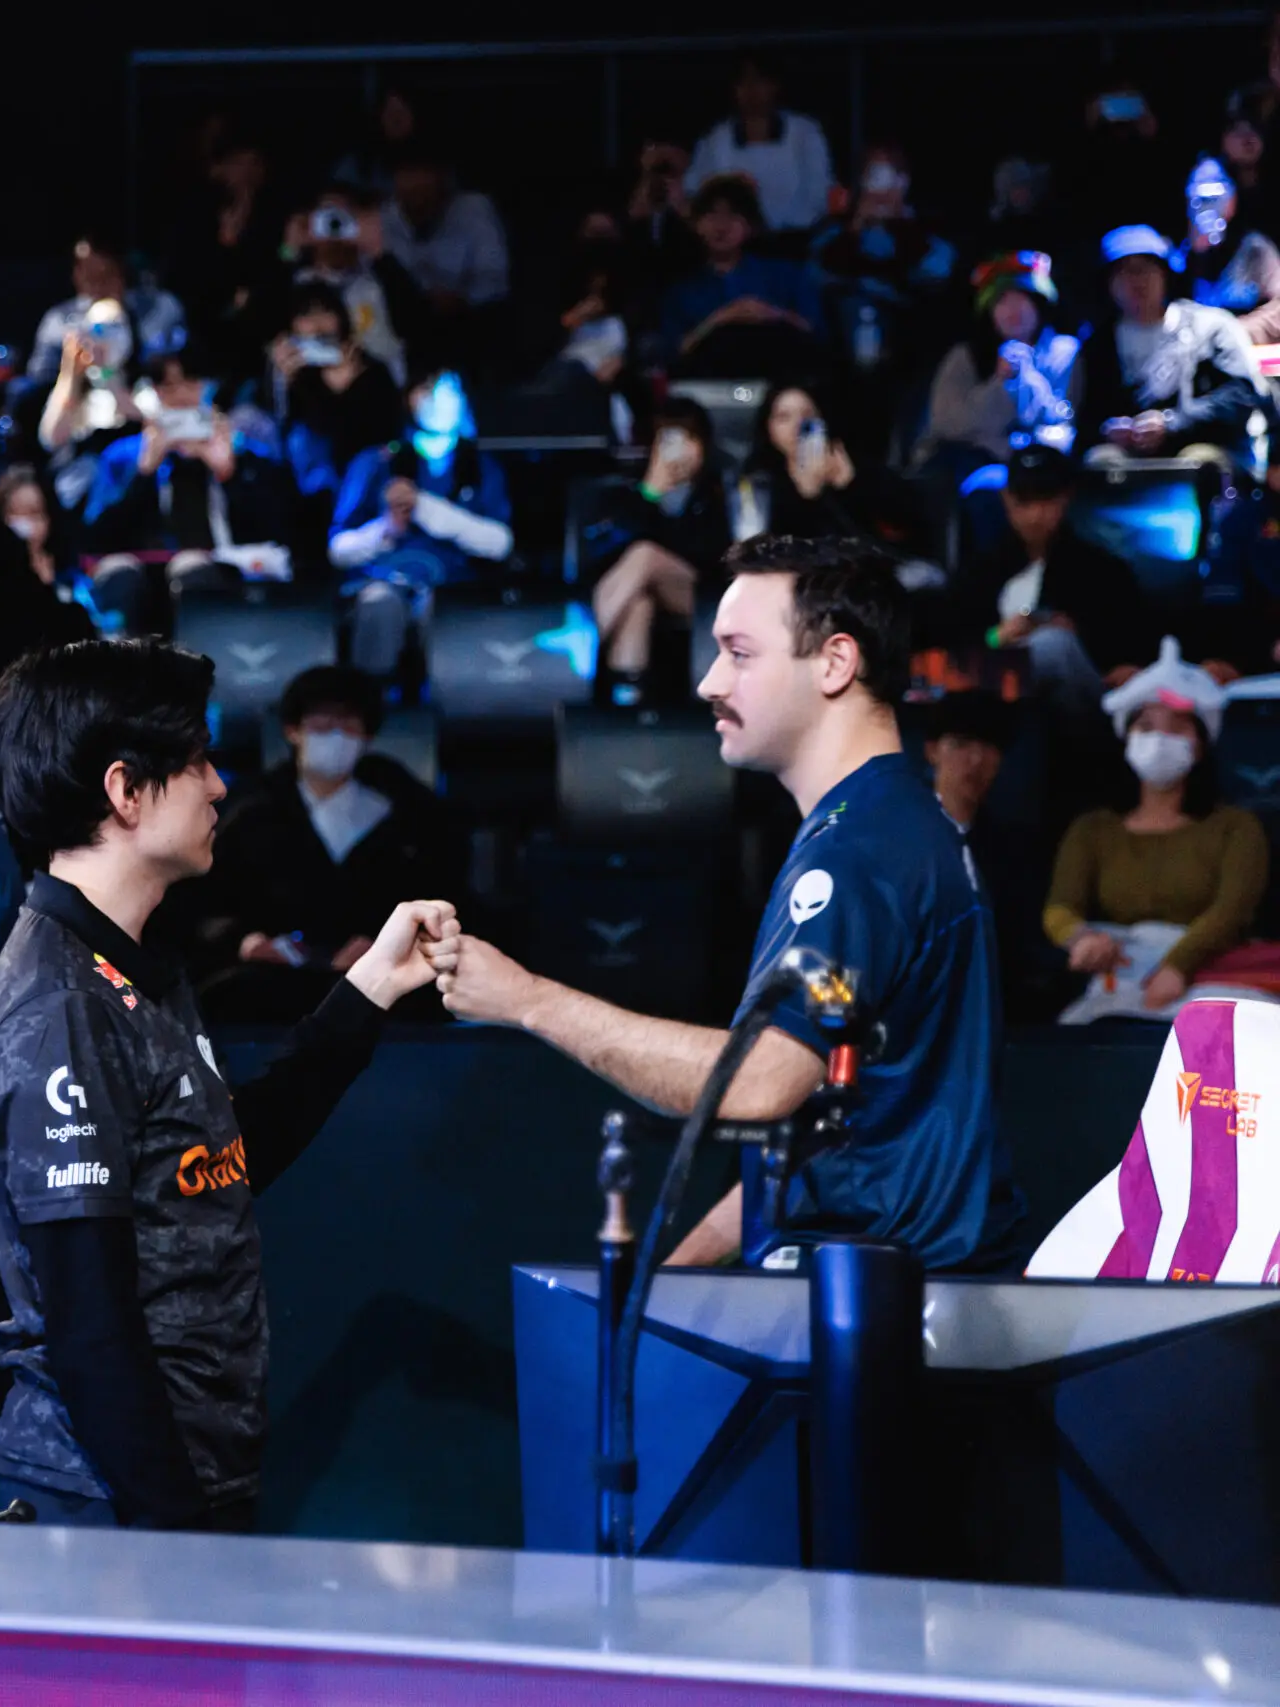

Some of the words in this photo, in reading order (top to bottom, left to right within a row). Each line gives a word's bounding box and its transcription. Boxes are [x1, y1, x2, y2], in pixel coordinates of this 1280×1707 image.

[1199, 1086, 1262, 1114] SECRET
[45, 1122, 97, 1143] logitech
[1226, 1115, 1258, 1139] LAB
[46, 1162, 110, 1189] fulllife
